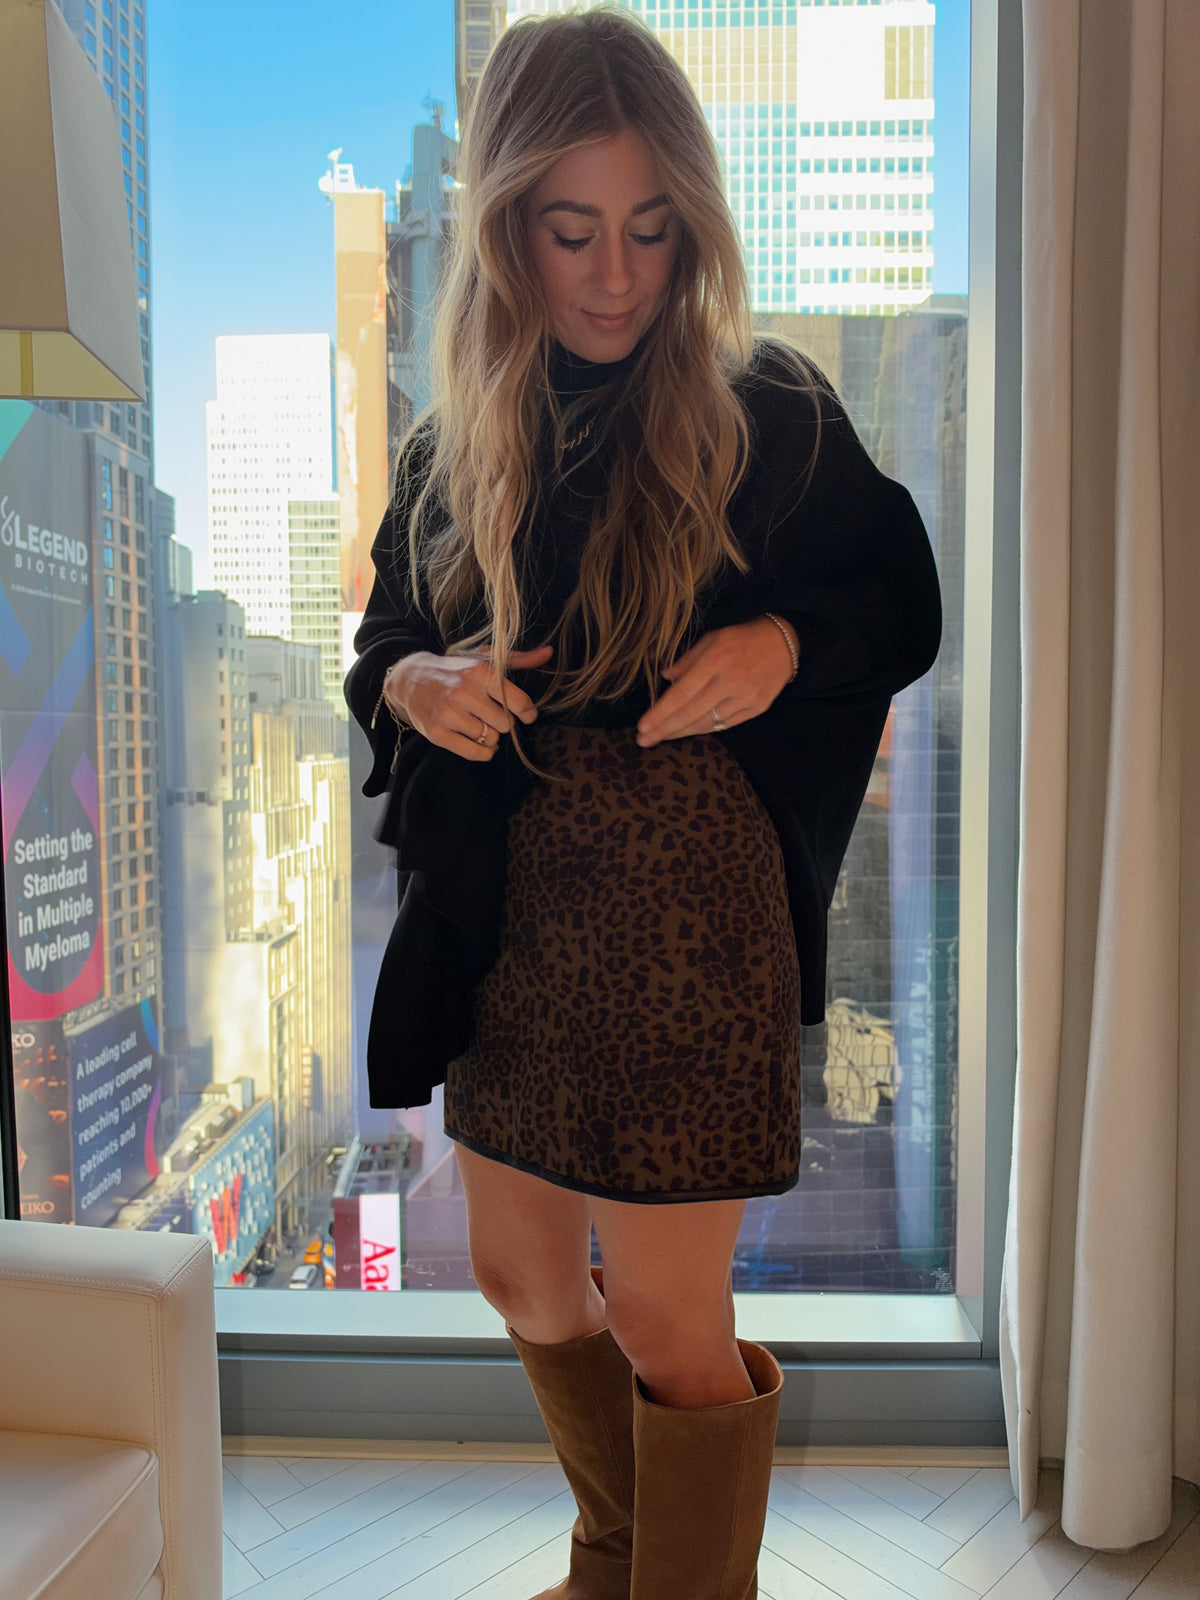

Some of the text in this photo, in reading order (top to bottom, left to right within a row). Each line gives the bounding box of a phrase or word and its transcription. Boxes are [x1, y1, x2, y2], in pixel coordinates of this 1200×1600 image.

[14, 515, 88, 567] LEGEND
[15, 555, 89, 585] BIOTECH
[14, 828, 93, 864] Setting the
[23, 860, 87, 899] Standard
[18, 893, 94, 937] in Multiple
[25, 930, 90, 972] Myeloma
[76, 1031, 137, 1080] A leading cell
[77, 1054, 153, 1114] therapy company
[78, 1107, 120, 1146] reaching
[79, 1122, 136, 1182] patients and
[80, 1167, 122, 1210] counting
